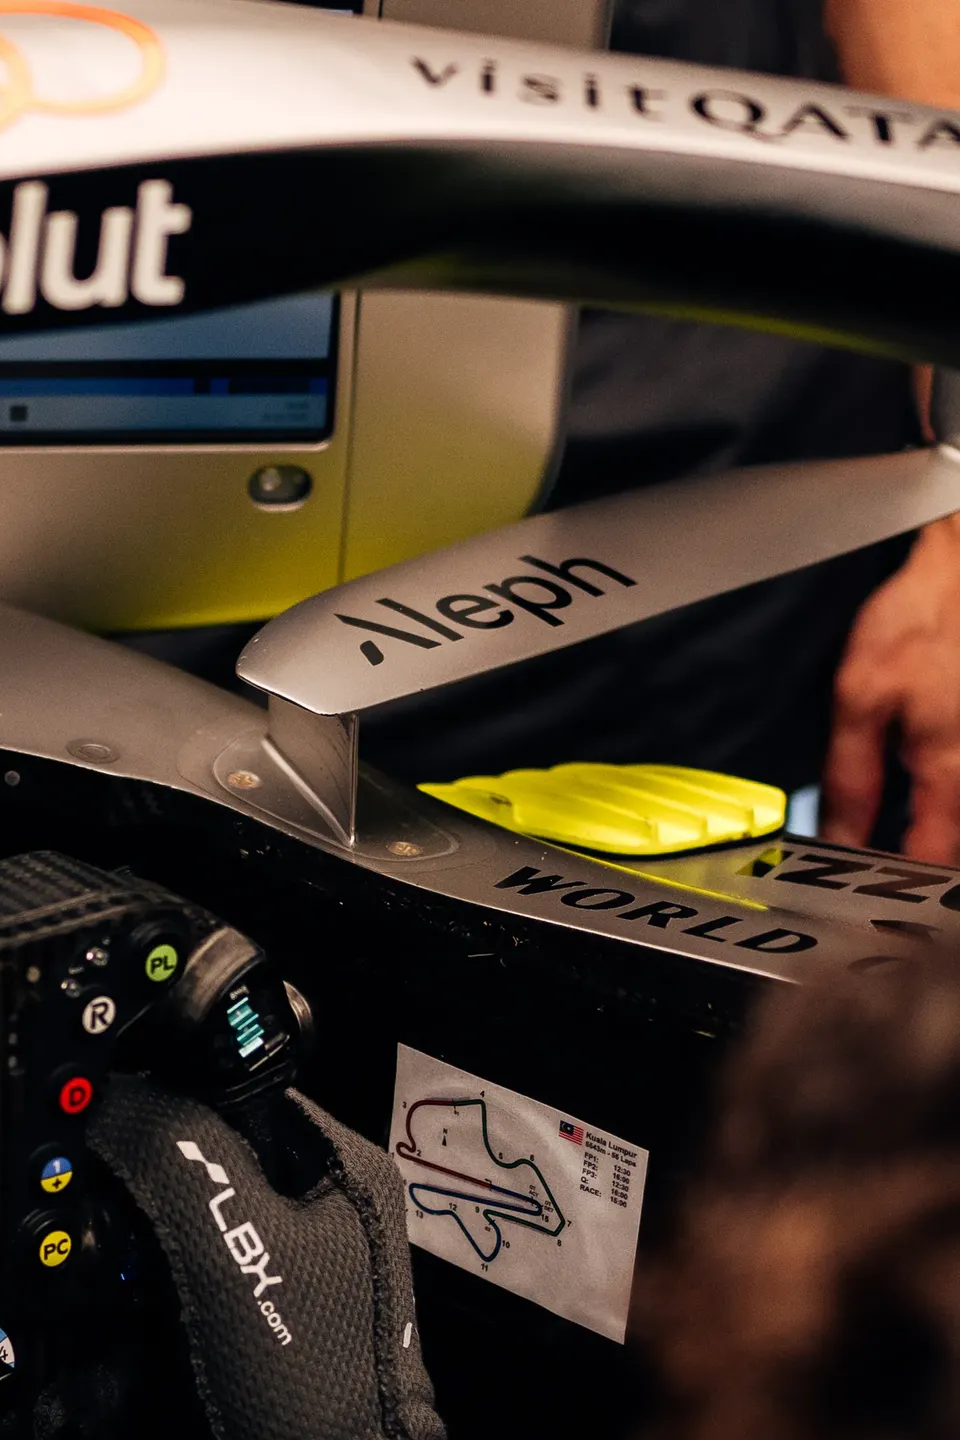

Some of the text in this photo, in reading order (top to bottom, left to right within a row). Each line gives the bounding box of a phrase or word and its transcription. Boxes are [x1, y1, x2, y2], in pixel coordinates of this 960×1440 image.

[333, 554, 638, 666] Aleph
[492, 864, 819, 955] WORLD
[150, 955, 175, 975] PL
[92, 1002, 109, 1030] R
[69, 1087, 86, 1107] D
[479, 1090, 485, 1098] 4
[402, 1101, 407, 1109] 3
[586, 1131, 638, 1159] Kuala Lumpur
[498, 1152, 503, 1160] 5
[583, 1159, 598, 1171] FP2:
[585, 1152, 631, 1177] FP1: 12:30
[621, 1155, 637, 1168] Laps
[581, 1176, 589, 1185] Q:
[582, 1167, 629, 1192] FP3: 12:30
[580, 1184, 627, 1208] RACE: 15:00
[415, 1210, 423, 1219] 13
[448, 1202, 457, 1211] 12
[44, 1238, 69, 1261] PC
[502, 1240, 510, 1249] 10
[209, 1187, 292, 1346] LBX.com
[481, 1263, 488, 1271] 11
